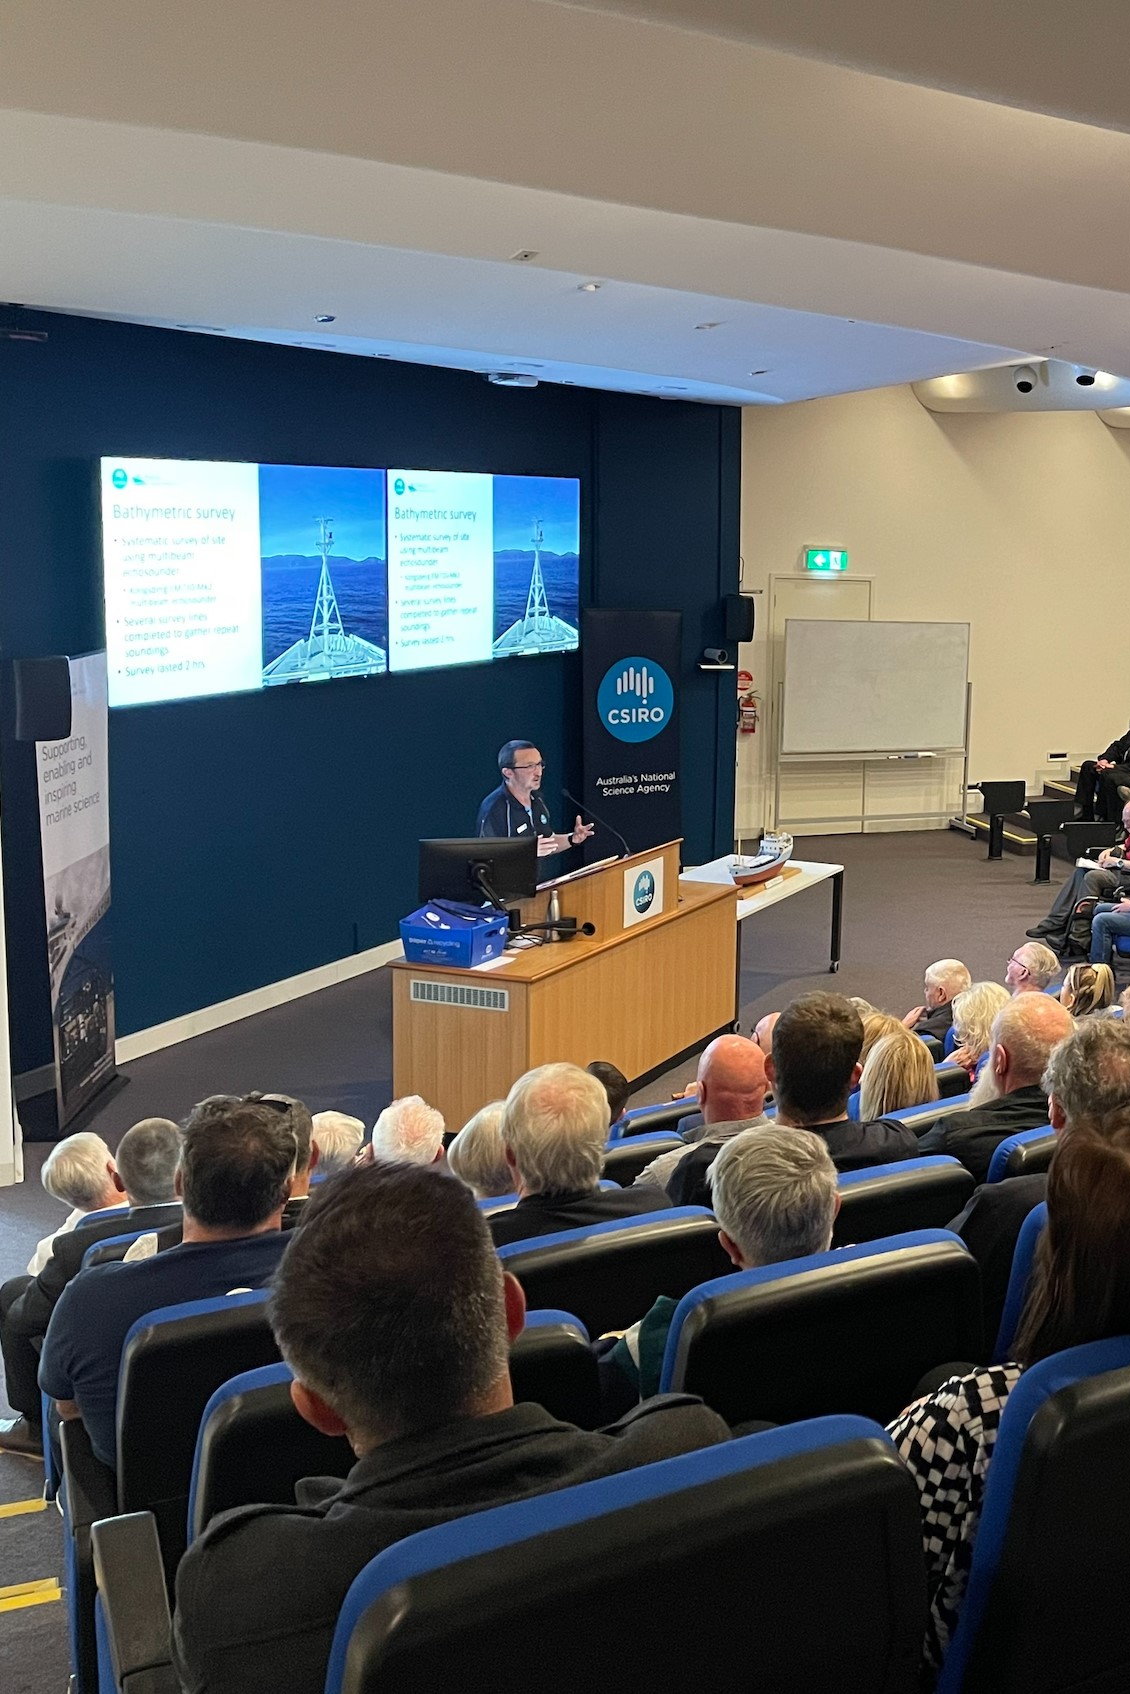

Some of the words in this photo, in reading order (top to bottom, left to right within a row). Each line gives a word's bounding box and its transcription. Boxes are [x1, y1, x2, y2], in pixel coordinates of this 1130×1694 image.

[113, 504, 192, 521] Bathymetric
[196, 507, 235, 522] survey
[394, 507, 447, 521] Bathymetric
[450, 510, 477, 522] survey
[121, 536, 168, 546] Systematic
[172, 537, 198, 546] survey
[201, 535, 209, 544] of
[212, 535, 226, 544] site
[122, 551, 145, 562] using
[148, 551, 194, 561] multibeam
[124, 615, 156, 626] Several
[159, 615, 186, 624] survey
[124, 629, 171, 642] completed
[174, 629, 182, 638] to
[214, 624, 239, 635] repeat
[125, 647, 169, 657] soundings
[125, 664, 155, 677] Survey
[157, 662, 183, 673] lasted
[185, 661, 190, 670] 2
[192, 659, 205, 669] hrs
[608, 707, 664, 725] CSIRO
[42, 734, 87, 762] Supporting,
[43, 756, 76, 783] enabling
[77, 751, 93, 770] and
[596, 774, 638, 786] Australia's
[640, 771, 676, 782] National
[44, 779, 77, 805] inspiring
[602, 786, 635, 796] Science
[636, 784, 670, 794] Agency
[45, 802, 73, 826] marine
[73, 791, 100, 814] science
[635, 893, 652, 906] CSIRO
